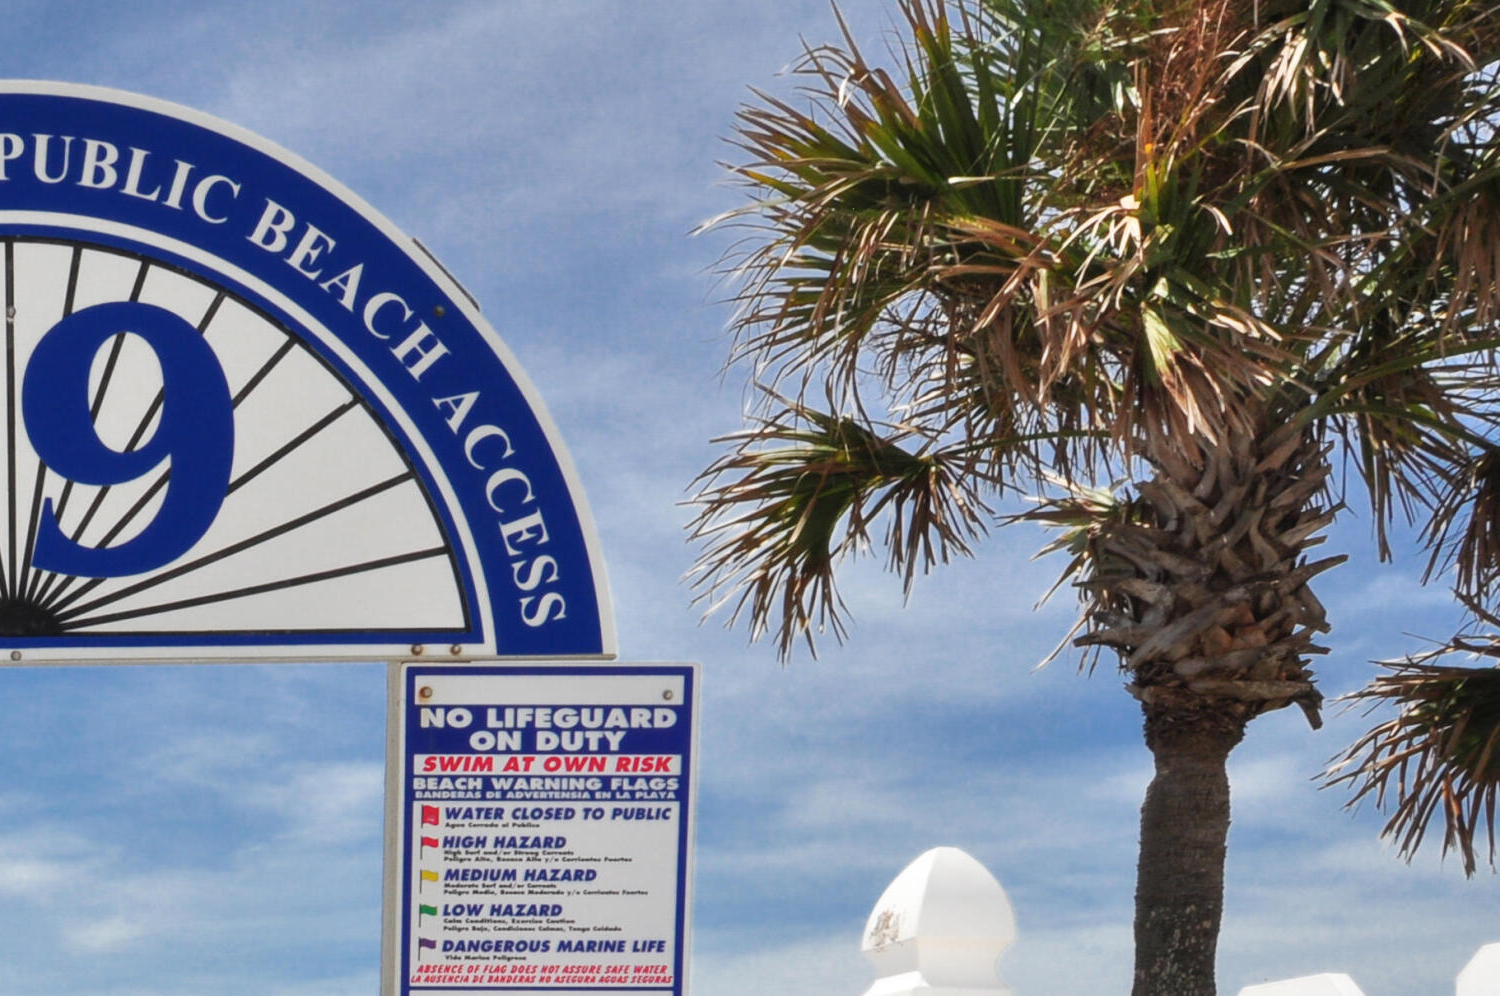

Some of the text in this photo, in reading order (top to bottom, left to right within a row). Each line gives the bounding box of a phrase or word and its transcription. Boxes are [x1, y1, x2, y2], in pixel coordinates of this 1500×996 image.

[245, 198, 451, 383] BEACH
[431, 390, 567, 629] ACCESS
[420, 707, 677, 729] NO LIFEGUARD
[470, 731, 626, 751] ON DUTY
[423, 756, 673, 772] SWIM AT OWN RISK
[413, 778, 679, 790] BEACH WARNING FLAGS
[415, 791, 482, 799] BANDERAS
[485, 791, 502, 799] DE
[595, 791, 612, 799] EN
[615, 791, 631, 799] LA
[635, 791, 676, 799] PLAYA
[445, 808, 672, 820] WATER CLOSED TO PUBLIC
[443, 837, 566, 849] HIGH HAZARD
[444, 869, 597, 882] MEDIUM HAZARD
[442, 904, 563, 917] LOW HAZARD
[442, 941, 667, 953] DANGEROUS MARINE LIFE
[417, 965, 668, 974] ABSENCE OF FLAG DOES NOT ASSURE SAFE WATER
[411, 975, 672, 984] LA AUSENCIA DE BANDERAS NO ASEGURA AGUAS SEGURAS
